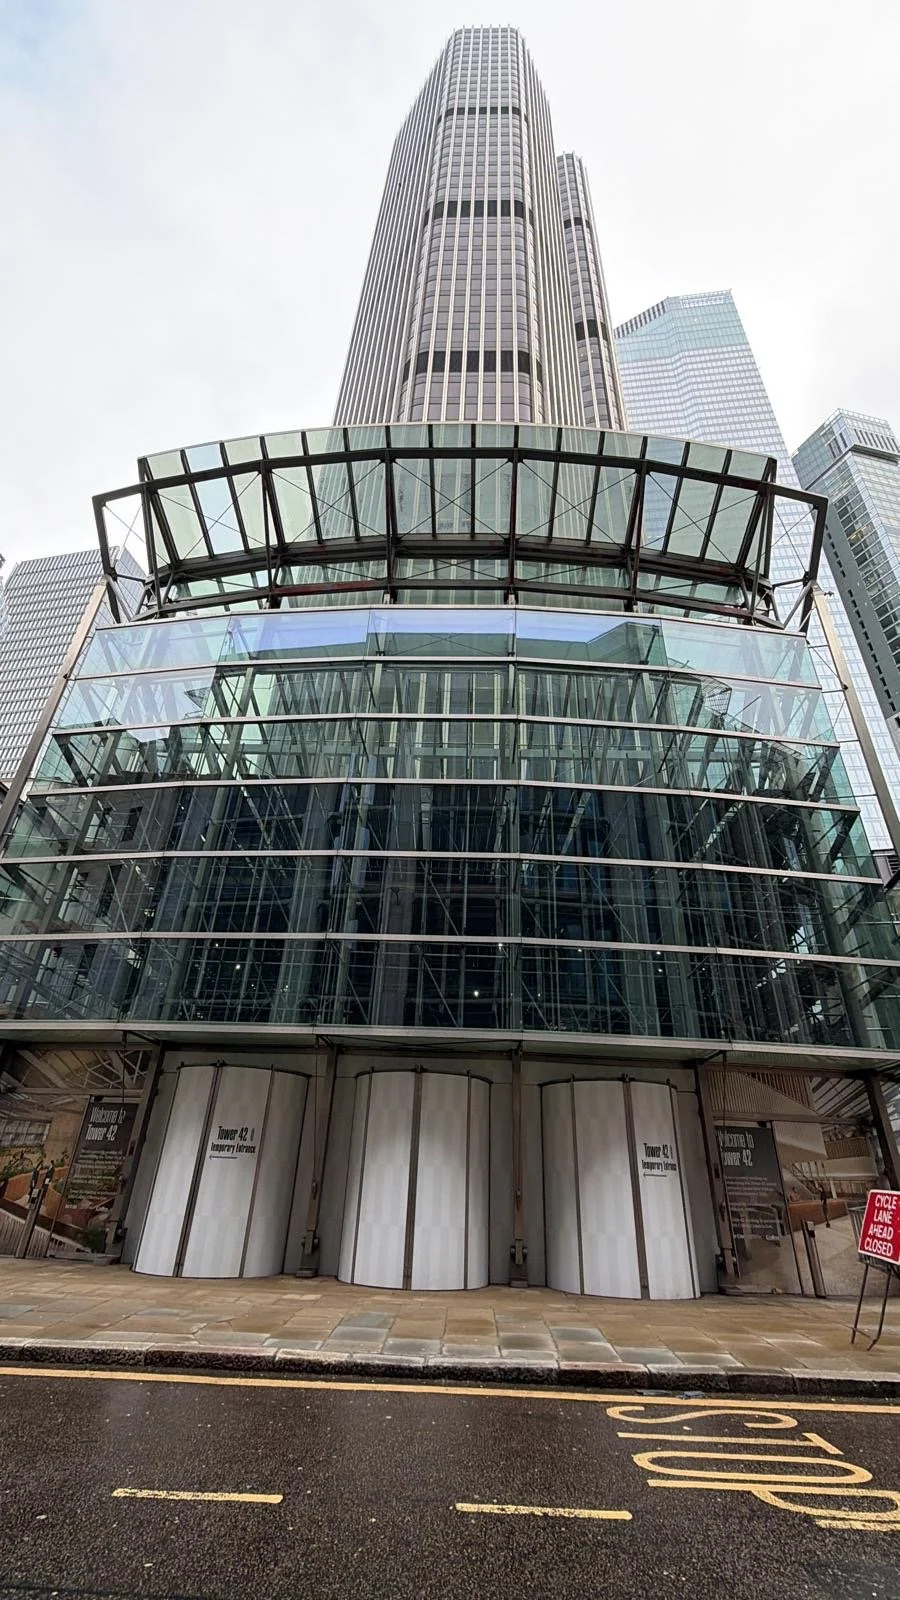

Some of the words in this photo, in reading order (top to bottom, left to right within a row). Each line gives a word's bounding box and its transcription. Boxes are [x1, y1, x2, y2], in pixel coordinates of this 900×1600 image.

[90, 1107, 118, 1123] Welcome
[85, 1124, 107, 1141] Tower
[107, 1124, 118, 1141] 42
[217, 1126, 238, 1141] Tower
[238, 1127, 249, 1141] 42
[211, 1142, 235, 1154] Temporary
[236, 1143, 256, 1154] Entrance
[643, 1143, 661, 1158] Tower
[662, 1144, 669, 1159] 42
[742, 1149, 753, 1167] 42
[874, 1194, 898, 1210] CYCLE
[873, 1209, 894, 1225] LANE
[868, 1223, 894, 1240] AHEAD
[864, 1237, 893, 1257] CLOSED
[606, 1405, 900, 1521] STOP
